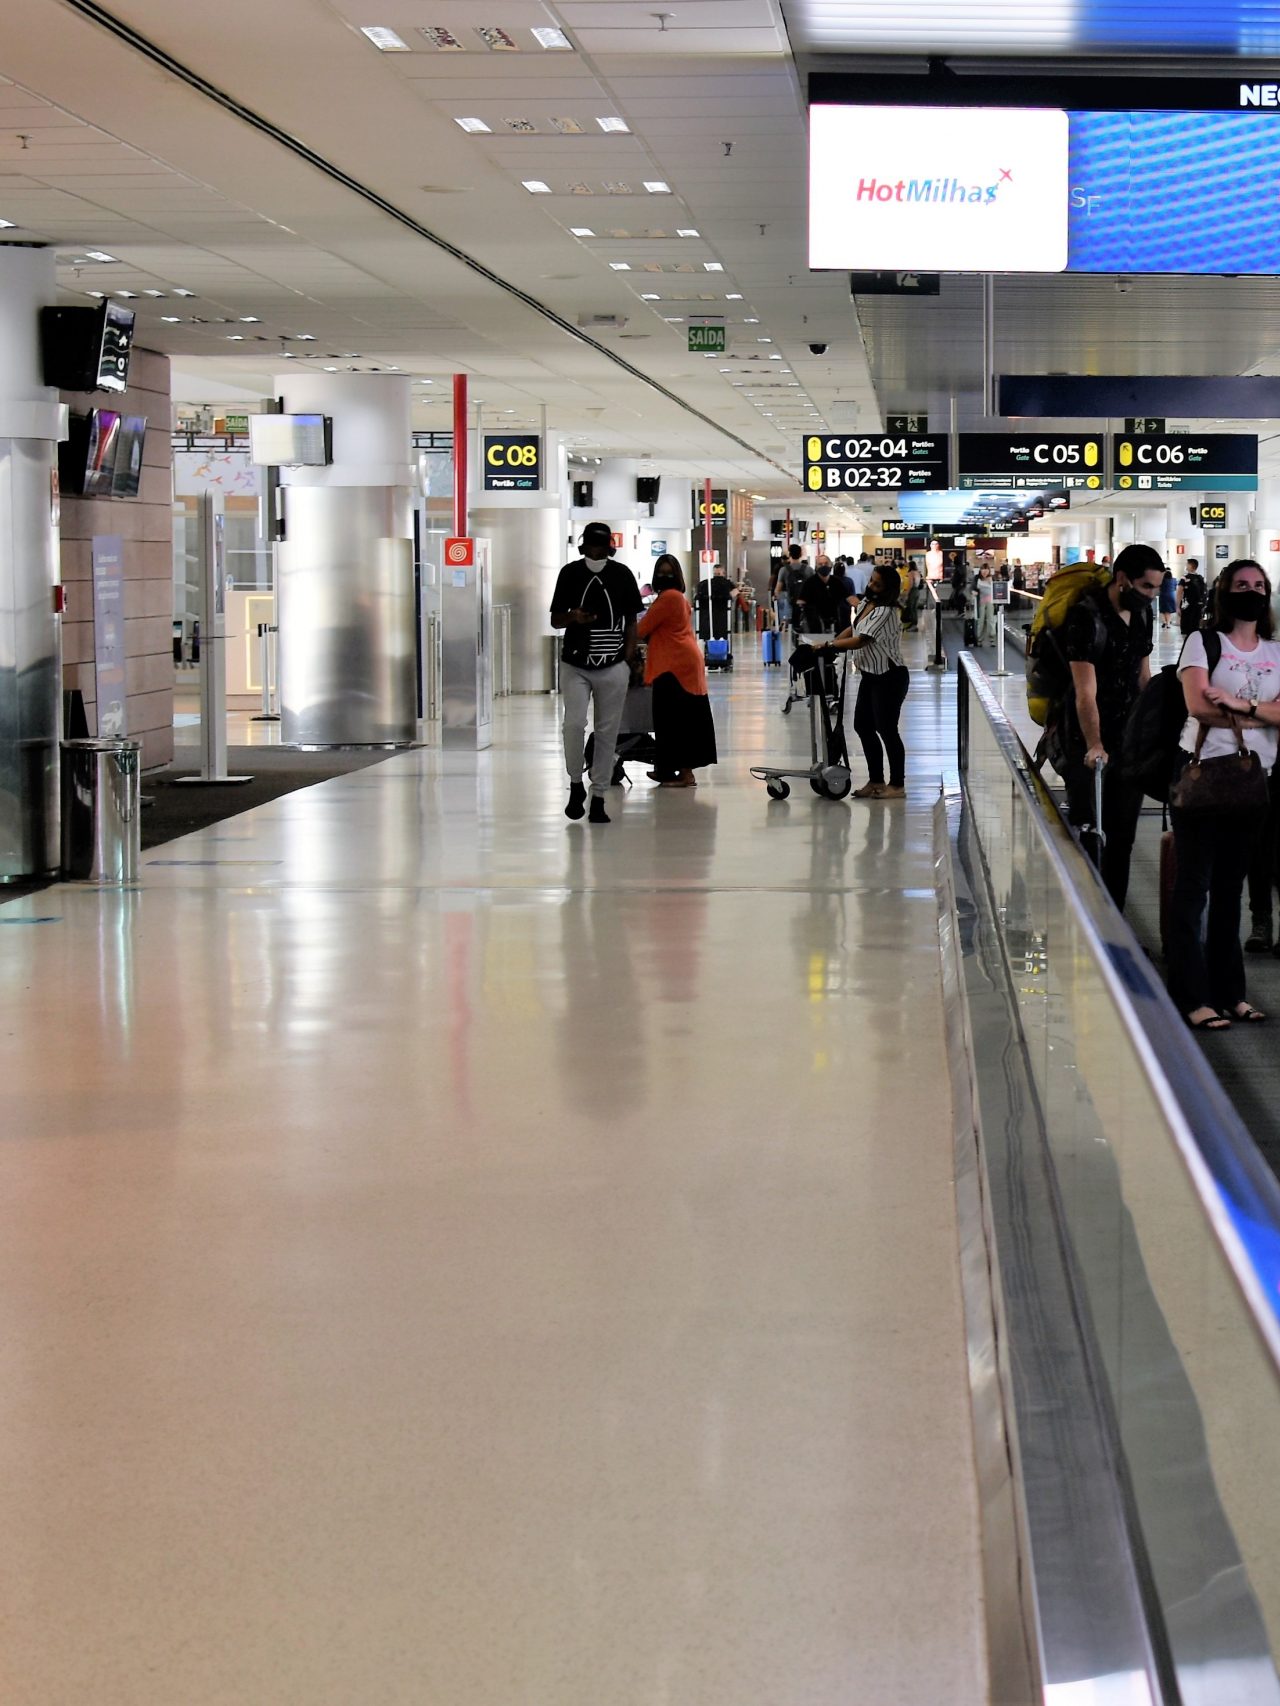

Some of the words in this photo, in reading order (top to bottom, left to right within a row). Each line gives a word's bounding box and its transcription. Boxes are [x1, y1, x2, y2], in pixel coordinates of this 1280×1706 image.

[856, 178, 999, 205] HotMilhas
[689, 328, 724, 345] SAÍDA
[487, 444, 504, 466] C
[506, 445, 537, 466] 08
[826, 439, 841, 459] C
[844, 439, 908, 458] 02-04
[1034, 444, 1049, 463] C
[1053, 444, 1080, 463] 05
[1137, 444, 1152, 464] C
[1156, 444, 1184, 464] 06
[1188, 447, 1208, 455] Portão
[827, 468, 841, 487] B
[844, 467, 902, 487] 02-32
[909, 469, 932, 477] Portões
[1201, 507, 1210, 518] C
[1210, 507, 1225, 518] 05
